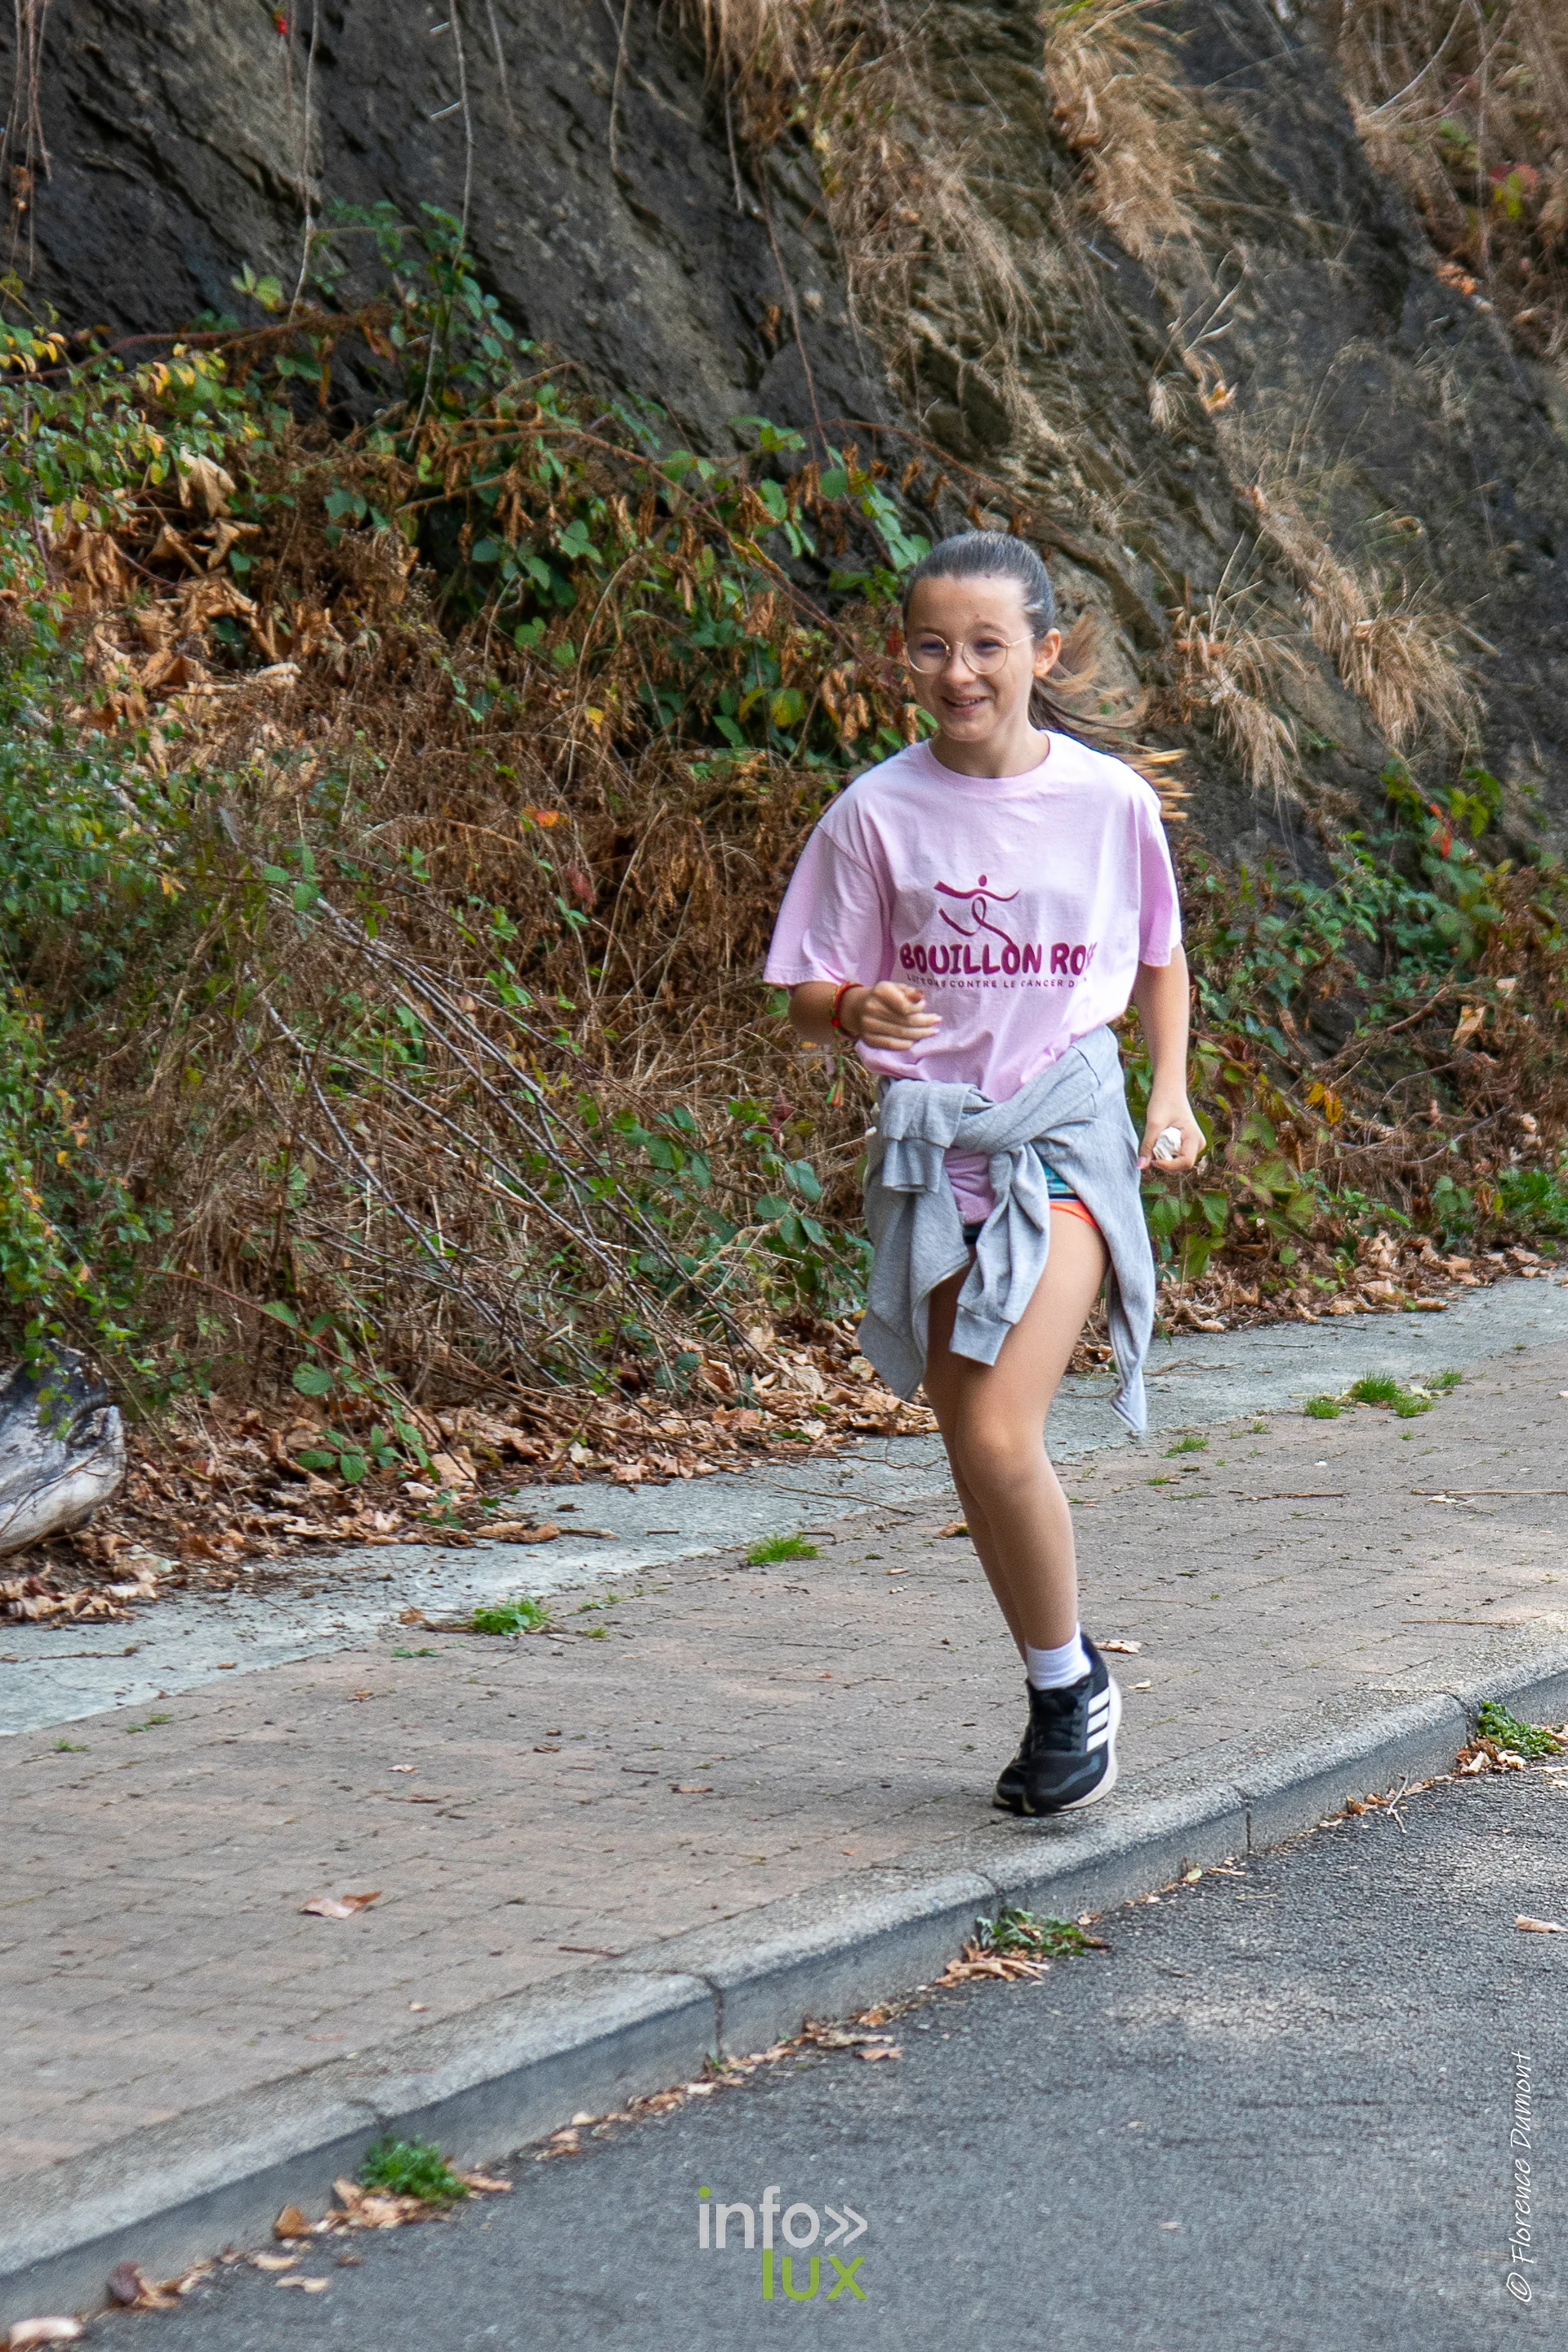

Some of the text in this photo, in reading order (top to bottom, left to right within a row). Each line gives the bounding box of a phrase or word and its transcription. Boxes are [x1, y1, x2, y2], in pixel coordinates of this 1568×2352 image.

[899, 942, 1042, 975] BOUILLON
[950, 980, 998, 988] CONTRE
[1004, 980, 1017, 988] LE
[1021, 978, 1064, 988] CANCER
